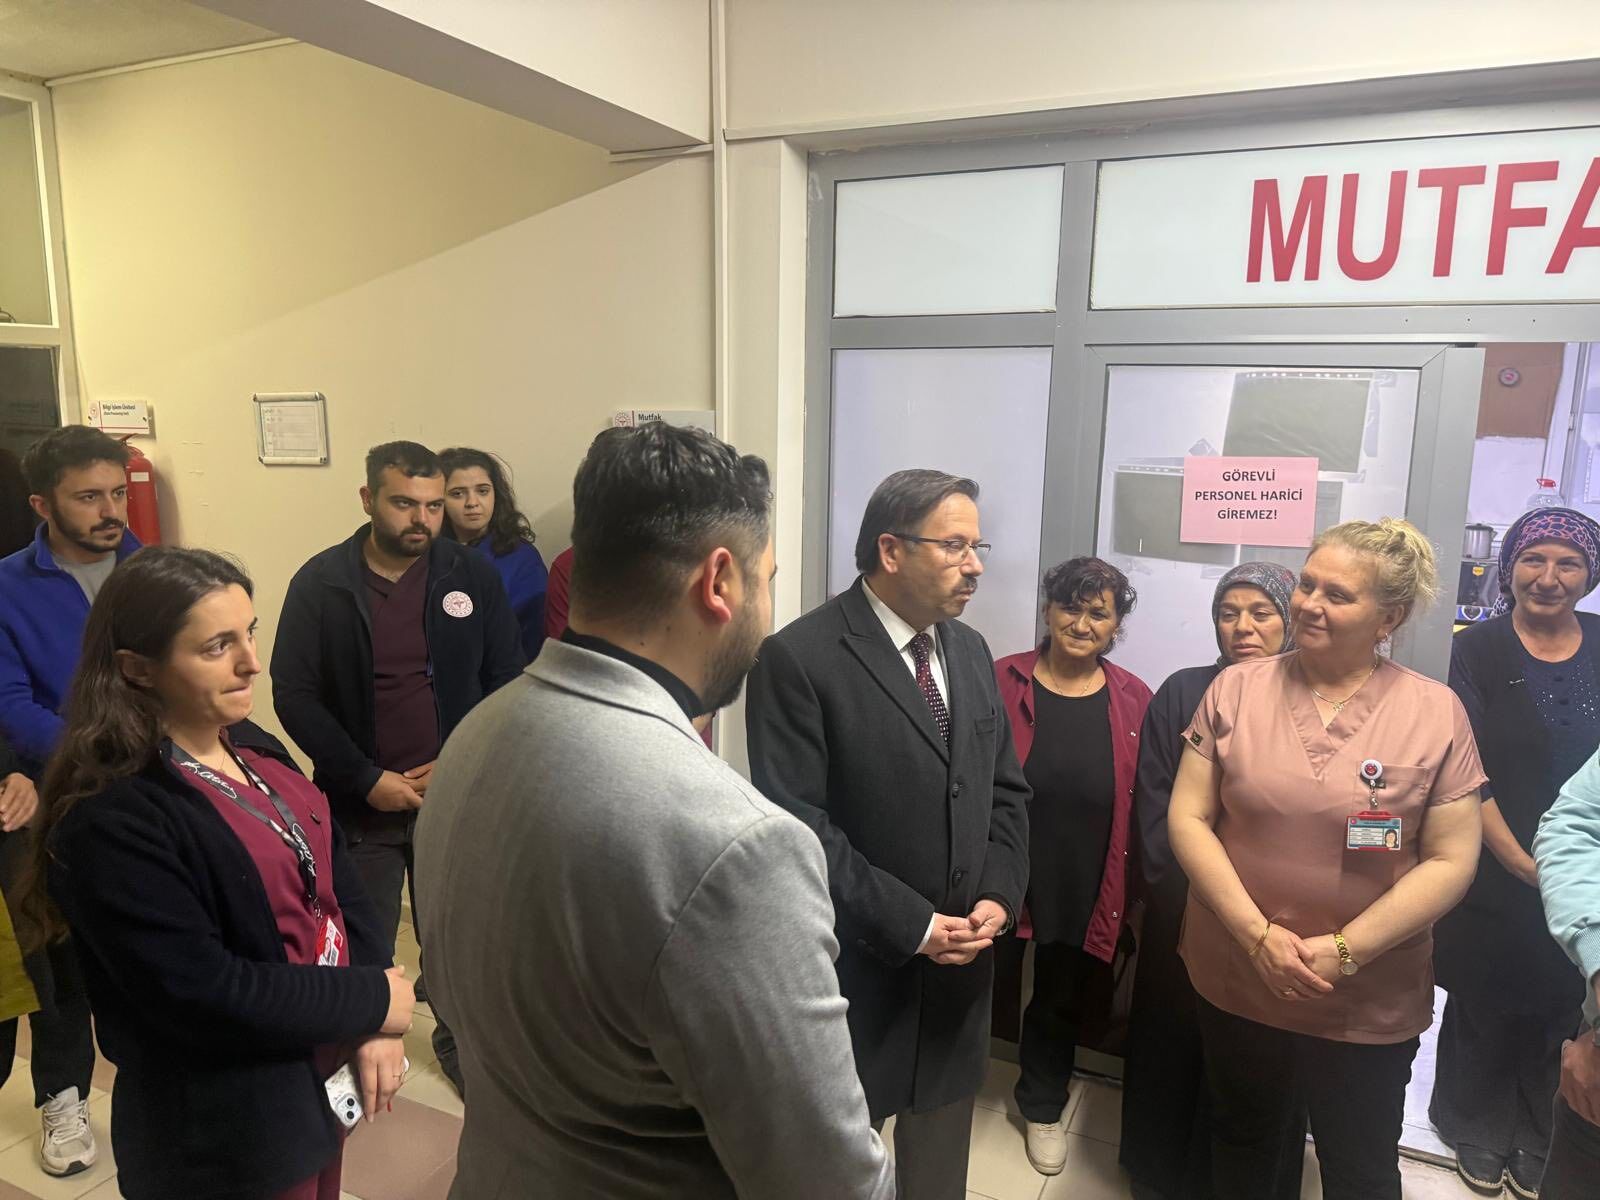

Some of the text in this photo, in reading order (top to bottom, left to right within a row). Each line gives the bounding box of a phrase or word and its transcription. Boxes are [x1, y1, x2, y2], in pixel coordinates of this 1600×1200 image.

[638, 413, 662, 421] Mutfak
[1222, 469, 1275, 481] GÖREVLİ
[1195, 488, 1303, 501] PERSONEL HARİCİ
[1217, 507, 1277, 520] GİREMEZ!
